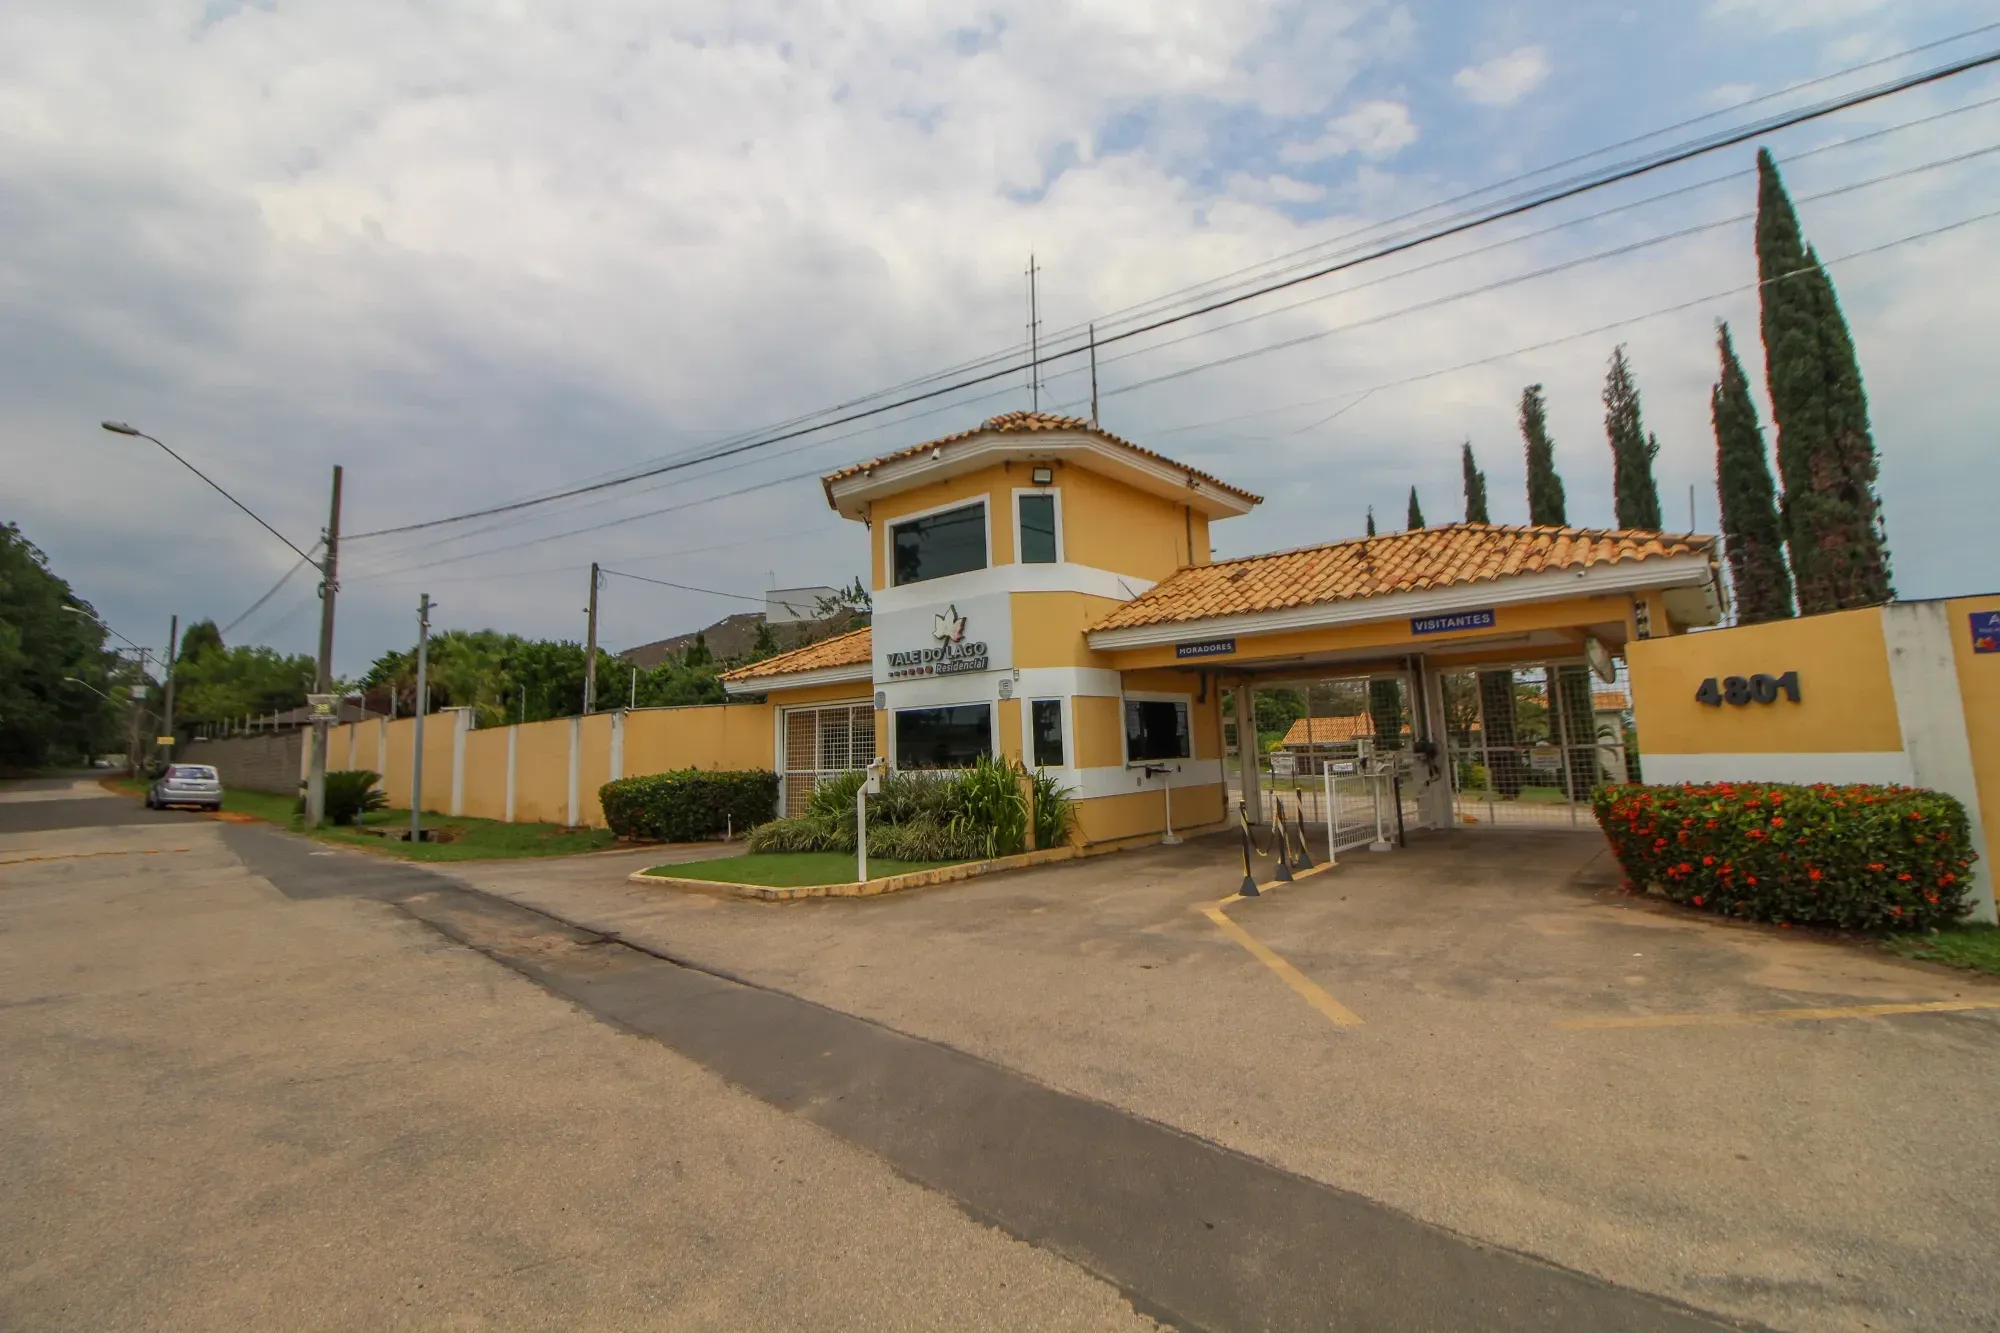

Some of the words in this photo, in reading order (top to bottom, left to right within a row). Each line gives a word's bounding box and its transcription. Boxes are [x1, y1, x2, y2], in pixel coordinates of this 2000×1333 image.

[1415, 613, 1490, 631] VISITANTES
[887, 650, 921, 667] VALE
[922, 647, 944, 662] DO
[945, 641, 987, 660] LAGO
[1179, 643, 1232, 654] MORADORES
[936, 658, 985, 673] Residencial
[1695, 670, 1802, 707] 4801
